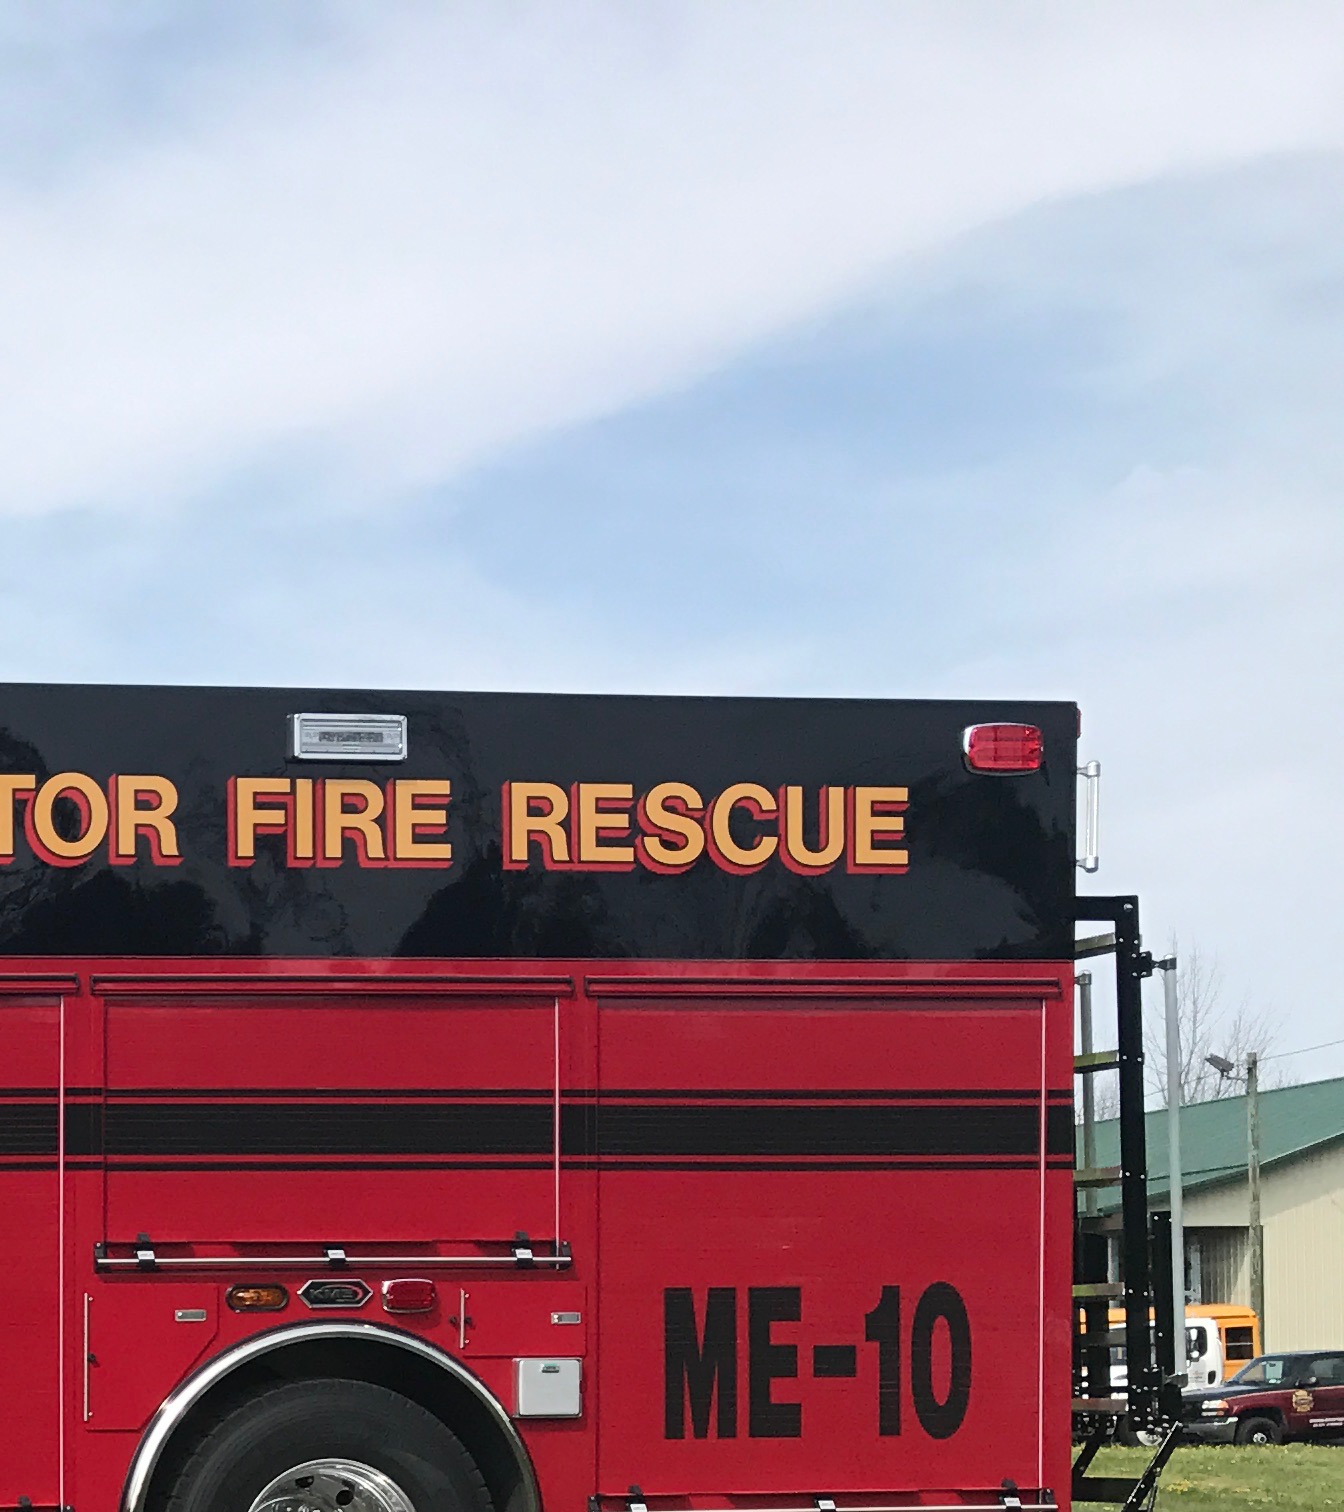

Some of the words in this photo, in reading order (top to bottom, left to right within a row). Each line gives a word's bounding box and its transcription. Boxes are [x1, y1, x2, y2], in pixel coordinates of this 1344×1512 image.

[227, 775, 453, 869] FIRE
[501, 781, 911, 876] RESCUE
[663, 1281, 972, 1440] ME-10
